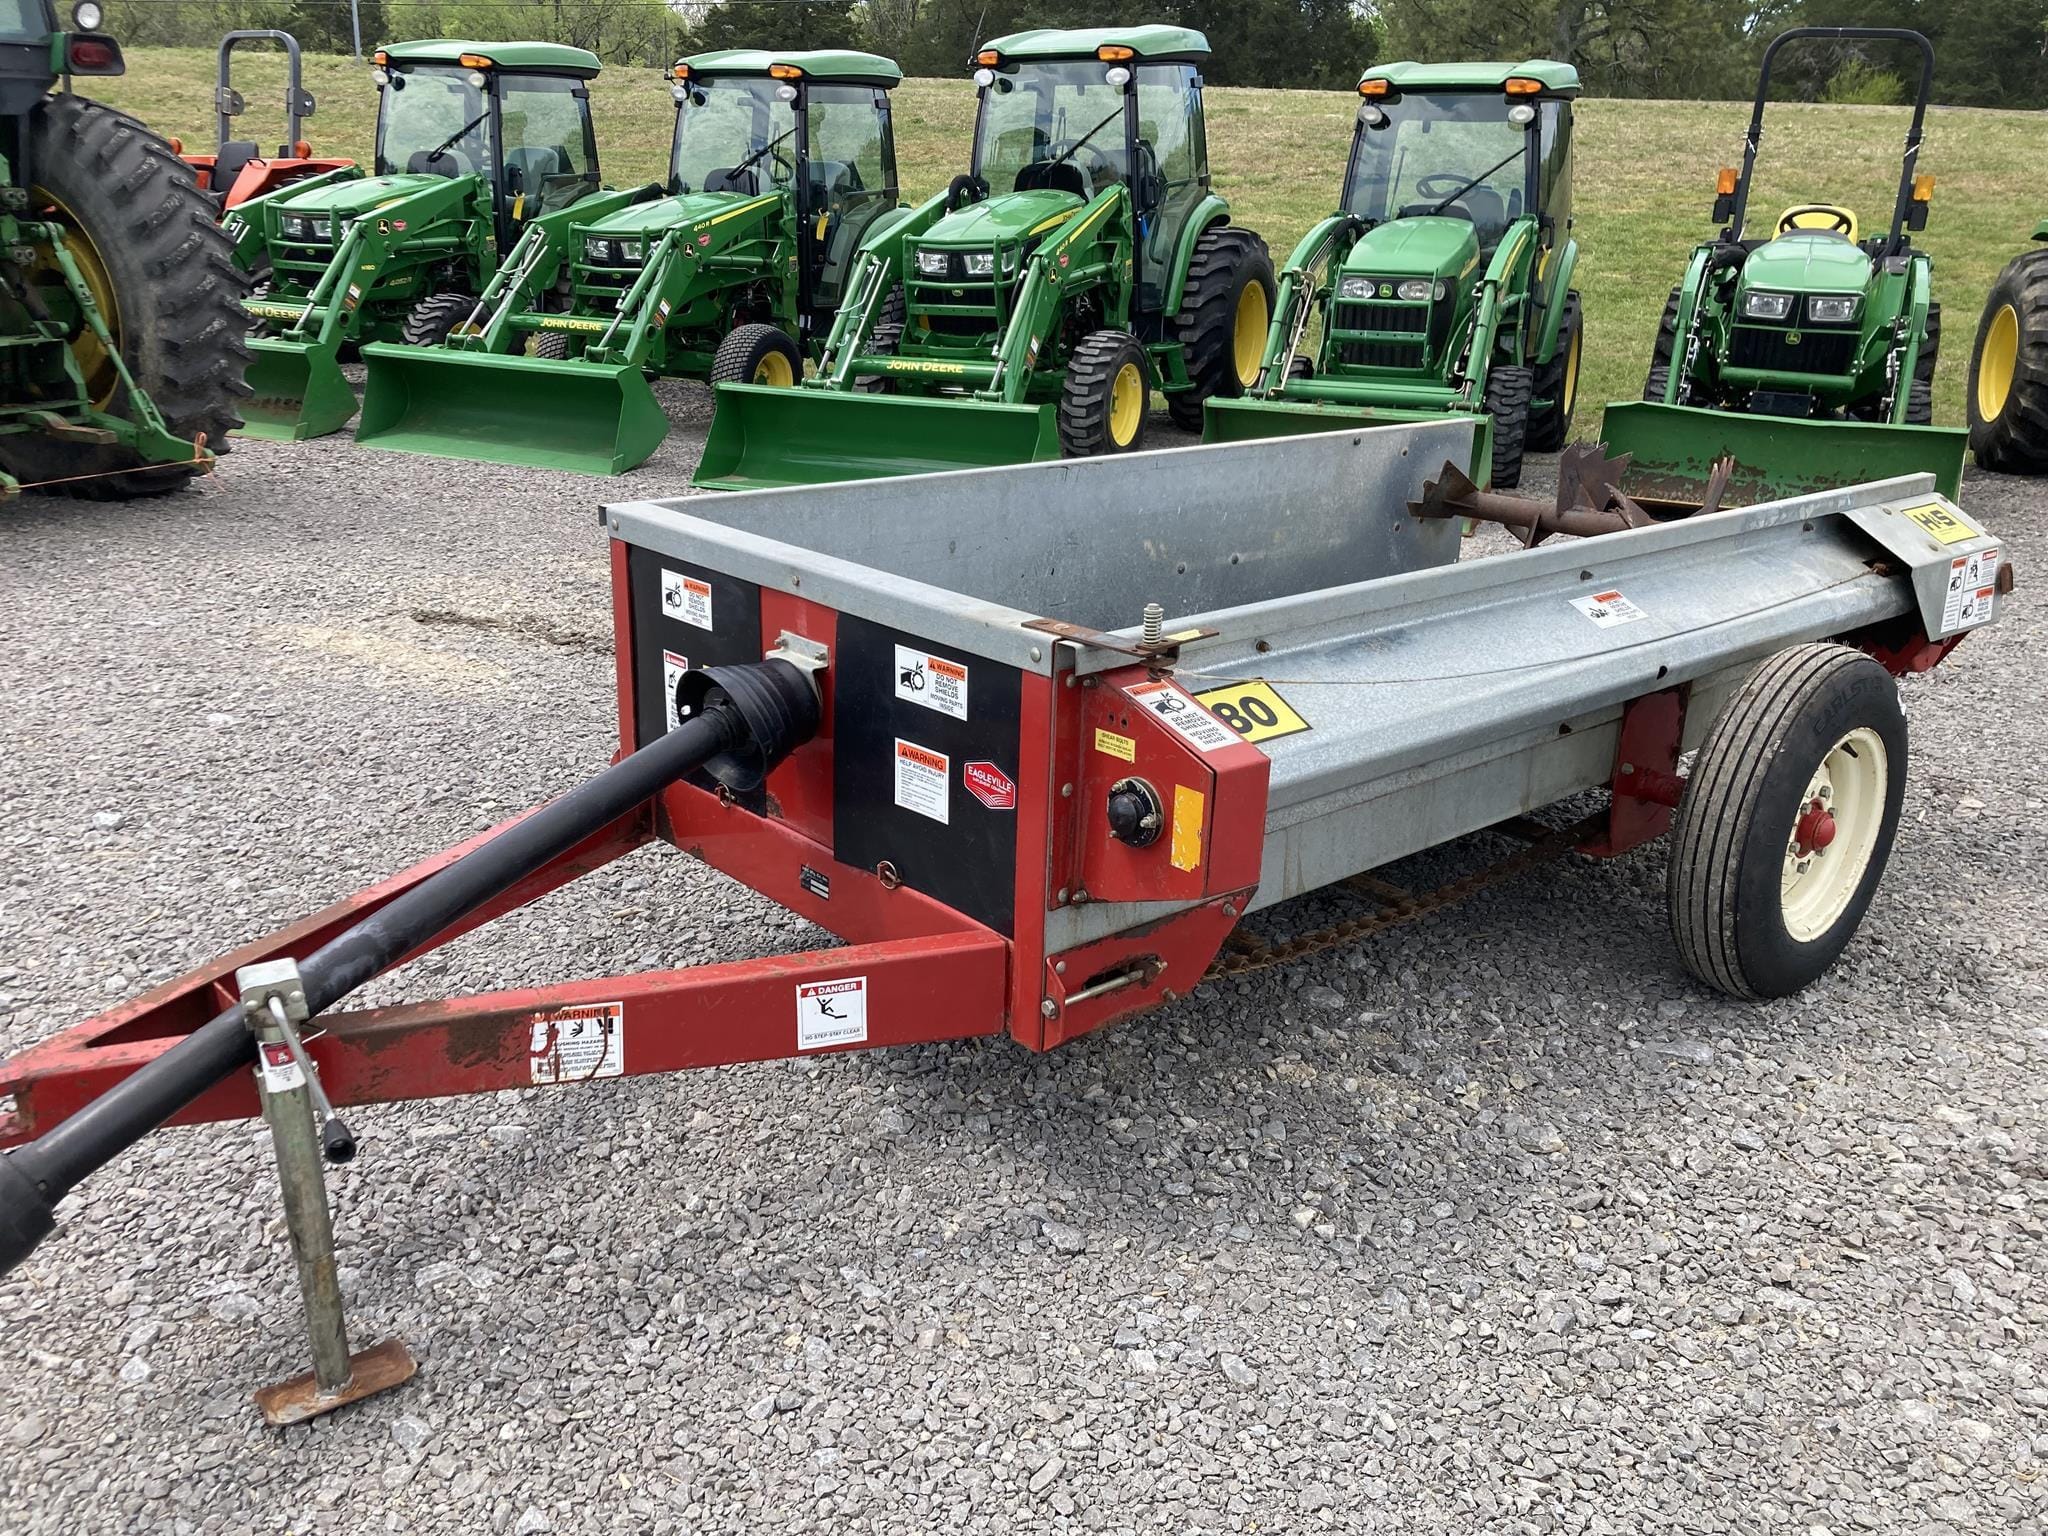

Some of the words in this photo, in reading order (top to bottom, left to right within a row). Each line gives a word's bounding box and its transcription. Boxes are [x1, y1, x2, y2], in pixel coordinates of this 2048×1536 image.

[265, 306, 304, 320] DEERE
[540, 317, 567, 329] JOHN
[568, 320, 602, 331] DEERE
[886, 360, 920, 371] JOHN
[922, 362, 964, 373] DEERE
[936, 663, 964, 678] WARNING
[935, 679, 959, 693] REMOVE
[946, 676, 957, 685] NOT
[935, 686, 959, 700] SHIELDS
[1175, 715, 1205, 727] REMOVE
[1183, 711, 1198, 720] NOT
[1179, 720, 1212, 731] SHIELDS
[1190, 726, 1220, 738] MOVING
[1198, 732, 1223, 741] PARTS
[1203, 736, 1228, 746] INSIDE
[908, 751, 944, 771] WARNING
[899, 759, 912, 768] HELP
[912, 763, 927, 773] AVOID
[927, 767, 945, 779] INJURY
[968, 765, 1012, 793] EAGLEVILLE
[818, 982, 857, 995] DANGER
[843, 1028, 861, 1036] CLEAR
